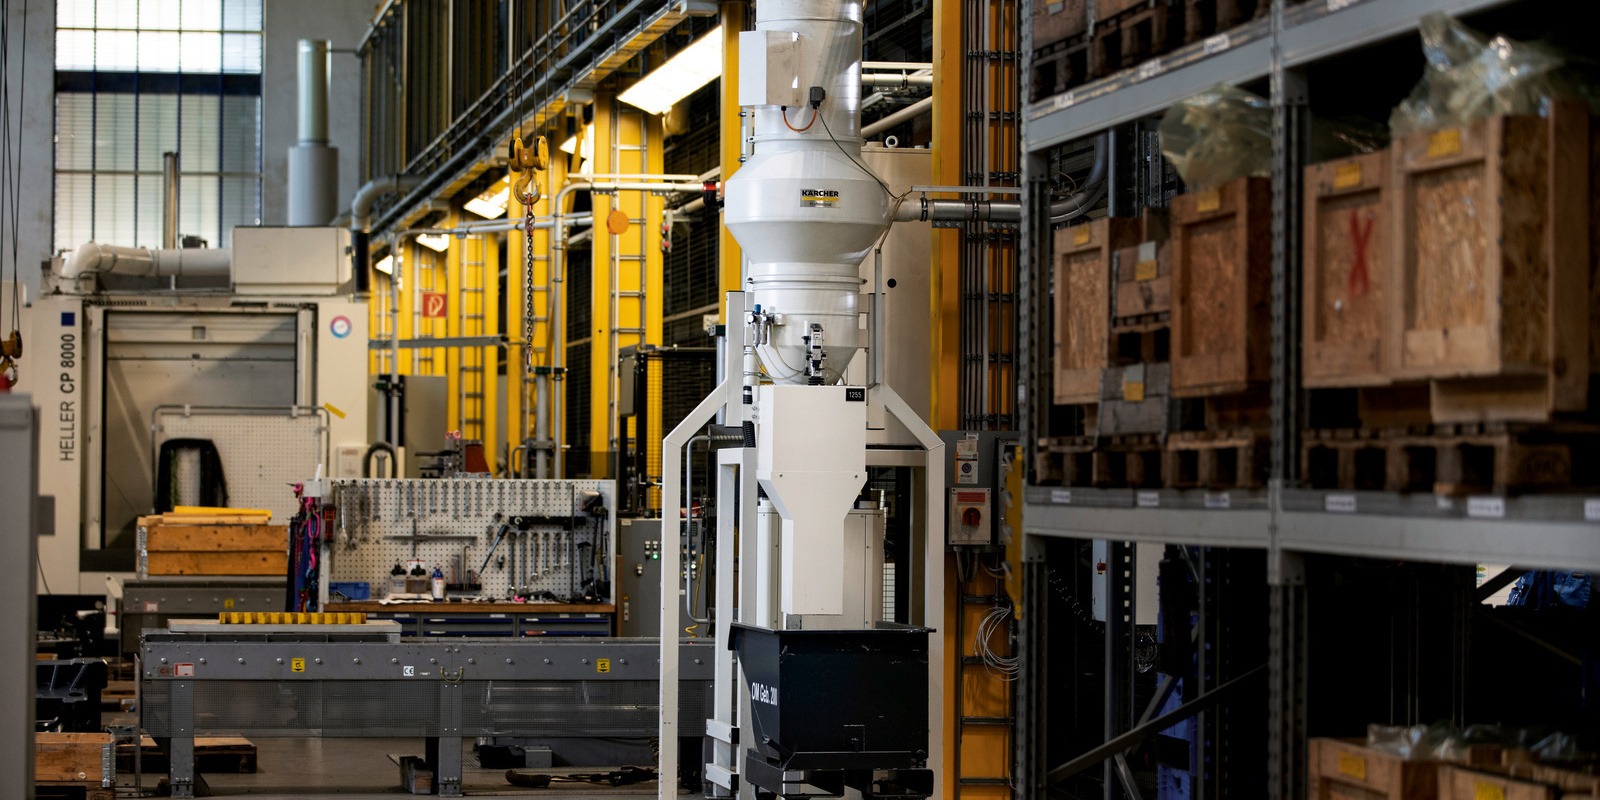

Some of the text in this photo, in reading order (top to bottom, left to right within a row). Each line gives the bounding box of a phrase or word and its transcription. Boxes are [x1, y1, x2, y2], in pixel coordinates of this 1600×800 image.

[60, 334, 75, 461] HELLER CP 8000
[849, 391, 862, 399] 1255
